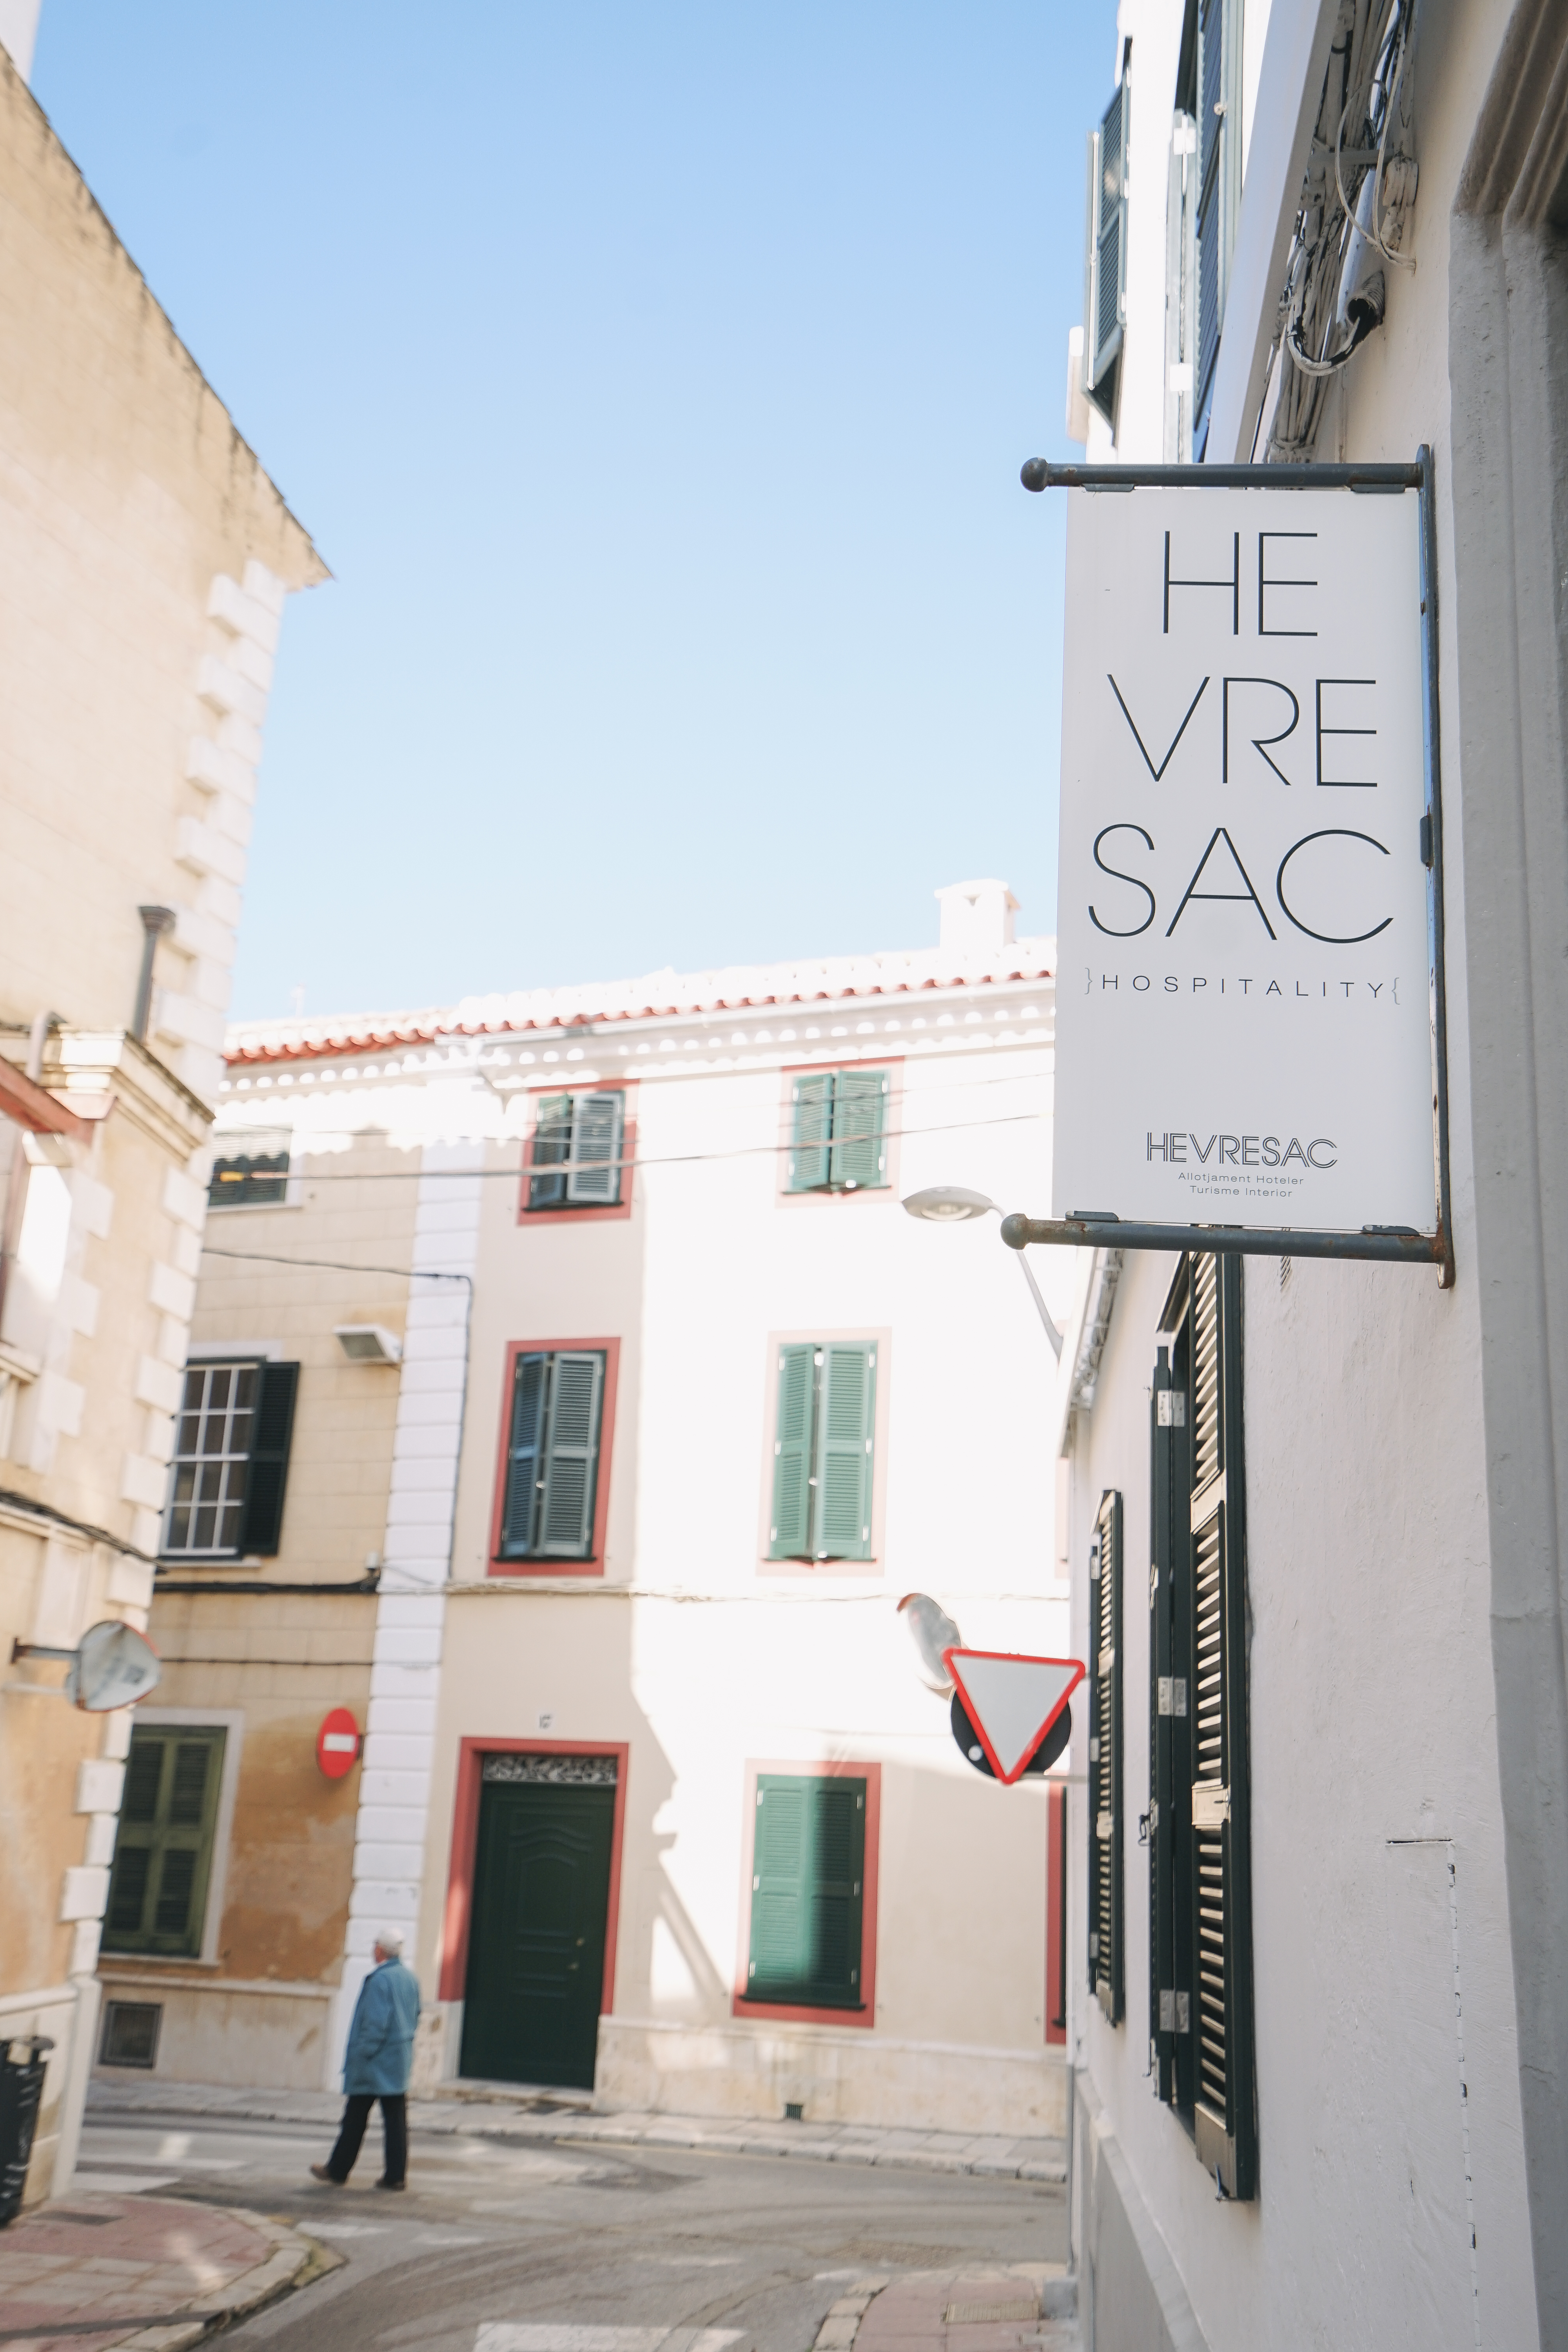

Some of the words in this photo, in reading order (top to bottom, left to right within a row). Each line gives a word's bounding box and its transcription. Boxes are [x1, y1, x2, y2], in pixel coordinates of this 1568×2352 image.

[1163, 530, 1318, 637] HE
[1107, 674, 1377, 788] VRE
[1088, 824, 1394, 944] SAC
[1147, 1132, 1338, 1169] HEVRESAC
[1178, 1172, 1251, 1183] Allotjament
[1256, 1175, 1304, 1185] Hoteler
[1189, 1185, 1240, 1195] Turisme
[1245, 1188, 1292, 1197] Interior
